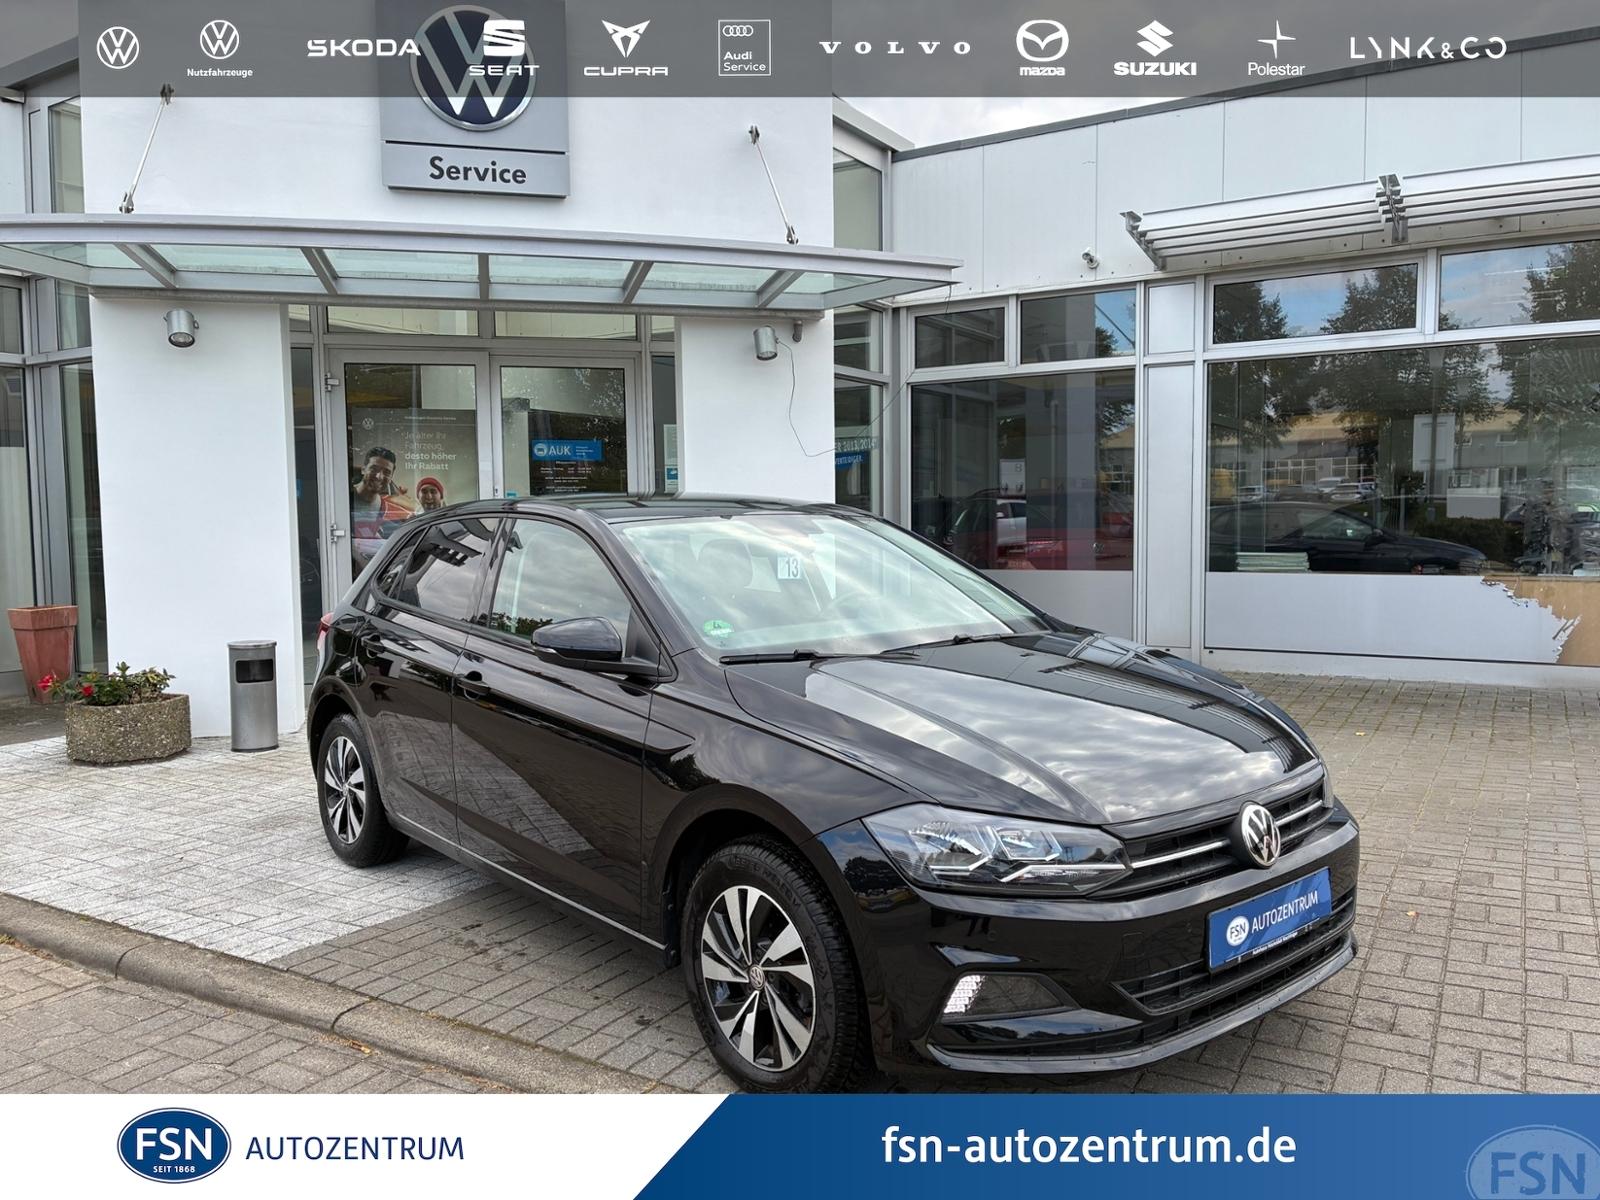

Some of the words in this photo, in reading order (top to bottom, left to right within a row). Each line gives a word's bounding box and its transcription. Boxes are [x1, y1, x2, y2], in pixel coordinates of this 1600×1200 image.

[429, 155, 527, 184] Service
[404, 451, 430, 460] desto
[431, 451, 457, 461] höher
[549, 446, 572, 455] AUK
[404, 462, 418, 470] Ihr
[419, 462, 449, 470] Rabatt
[785, 558, 799, 578] 13
[1229, 921, 1246, 939] FSN
[1251, 890, 1318, 934] AUTOZENTRUM
